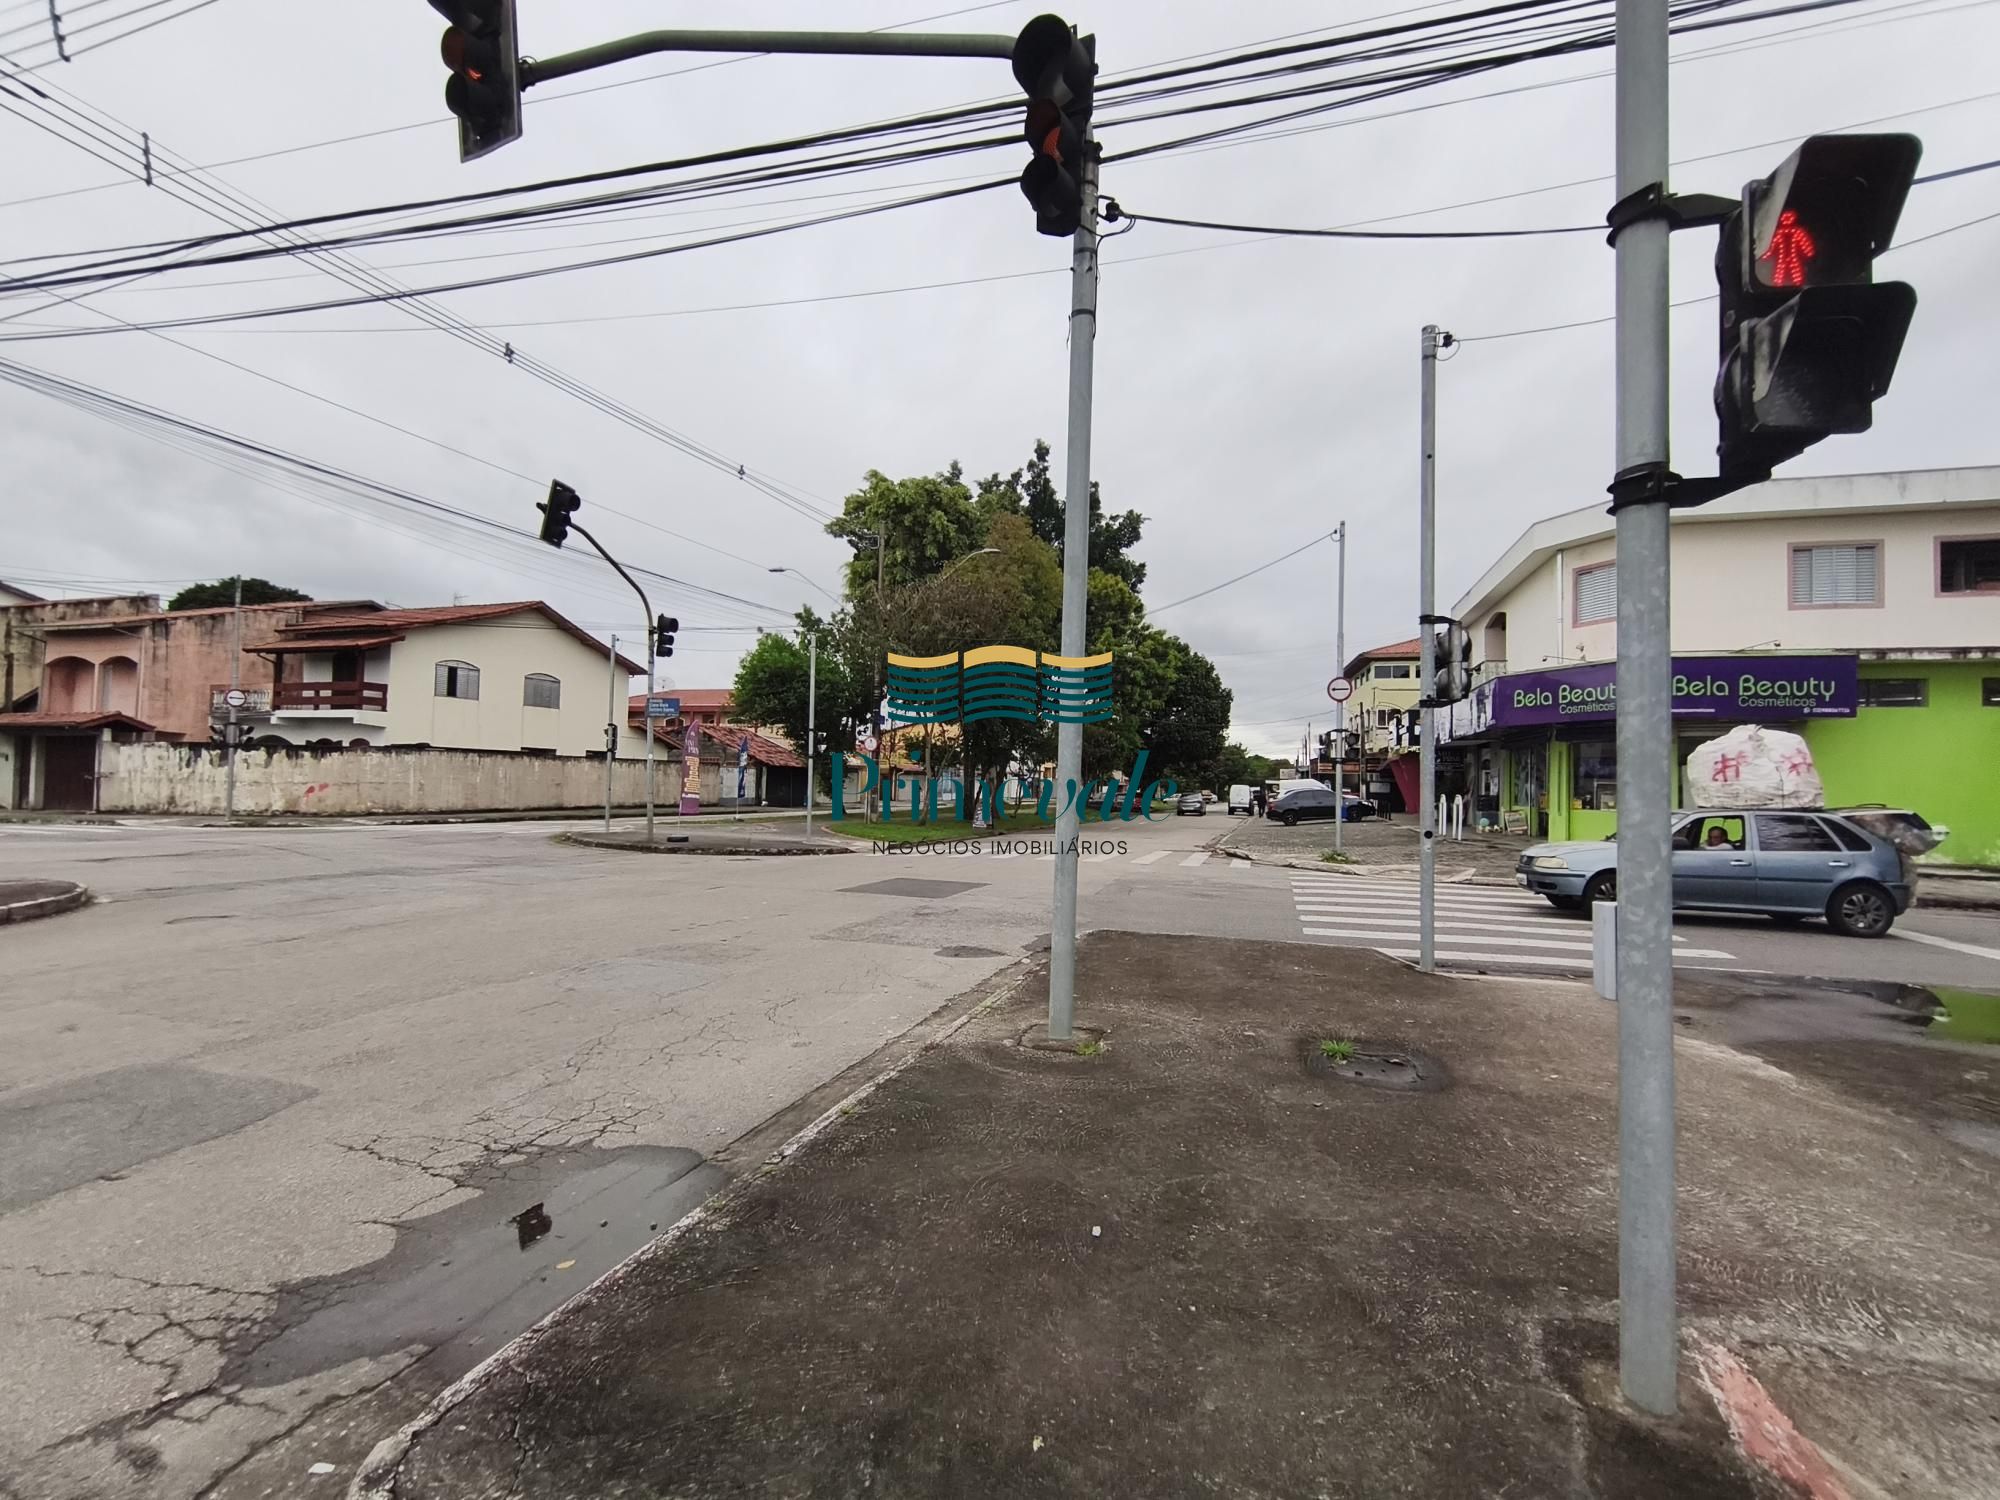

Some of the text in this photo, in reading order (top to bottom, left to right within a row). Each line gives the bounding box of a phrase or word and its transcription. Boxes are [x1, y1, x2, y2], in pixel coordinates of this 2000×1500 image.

[1513, 682, 1617, 708] Bela Beaut
[1672, 674, 1836, 702] Bela Beauty
[1559, 702, 1617, 715] Cosméticos
[1738, 695, 1817, 708] Cosméticos
